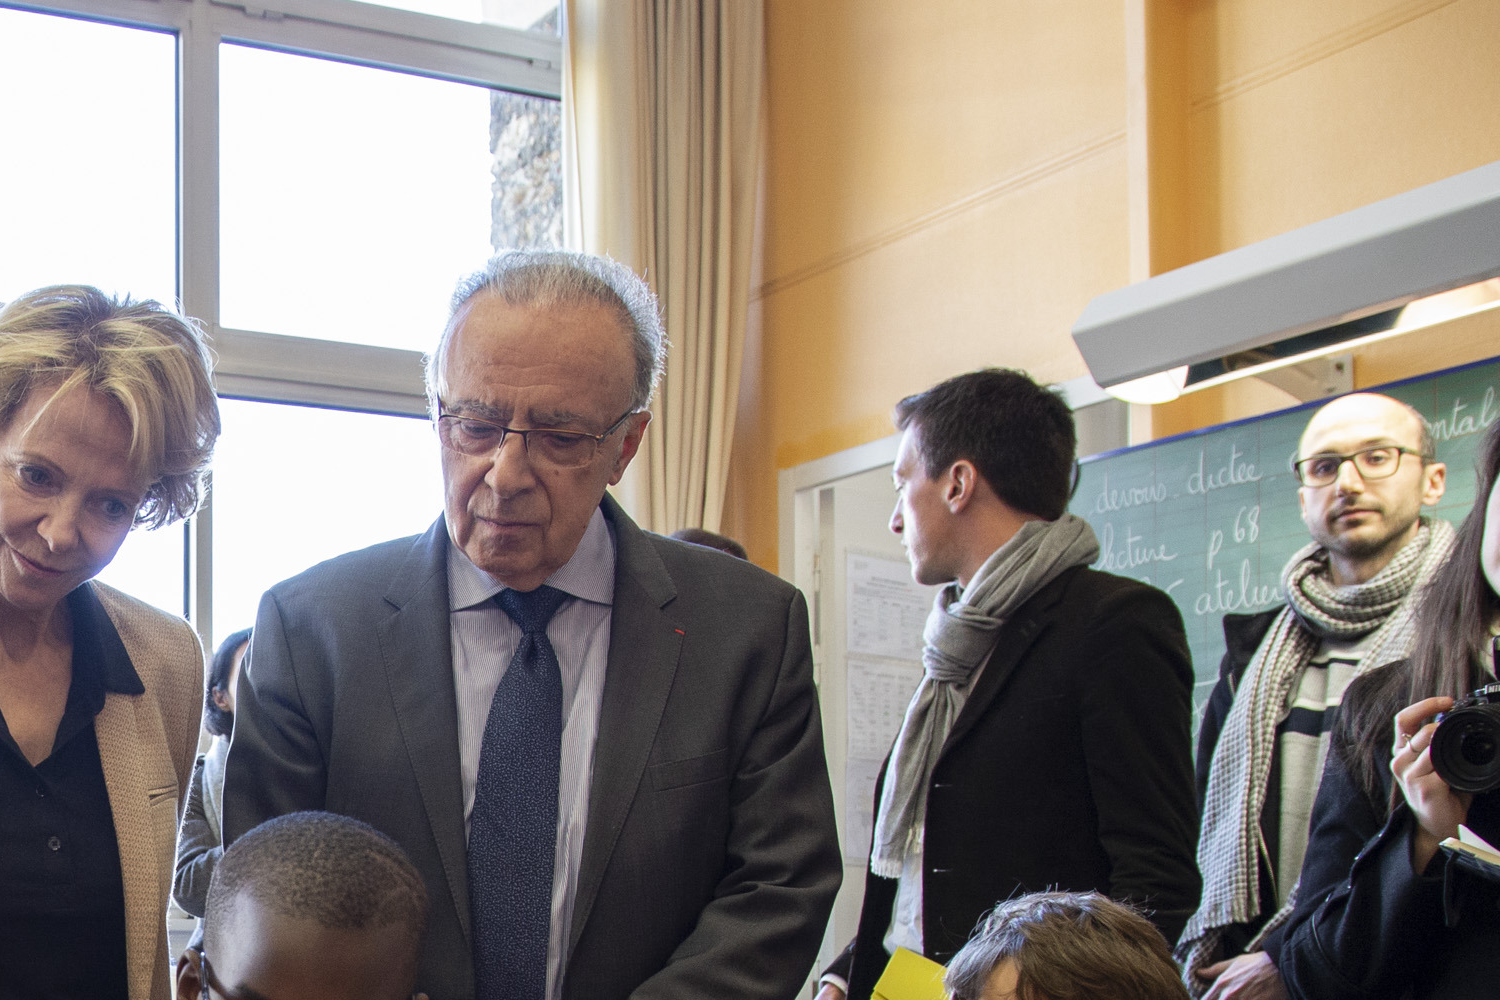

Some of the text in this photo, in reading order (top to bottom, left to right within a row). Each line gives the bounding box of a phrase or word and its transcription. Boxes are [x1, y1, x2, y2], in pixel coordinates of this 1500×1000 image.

[1431, 386, 1497, 441] ntal
[1097, 473, 1167, 514] devoirs
[1099, 505, 1260, 571] lecture p 68
